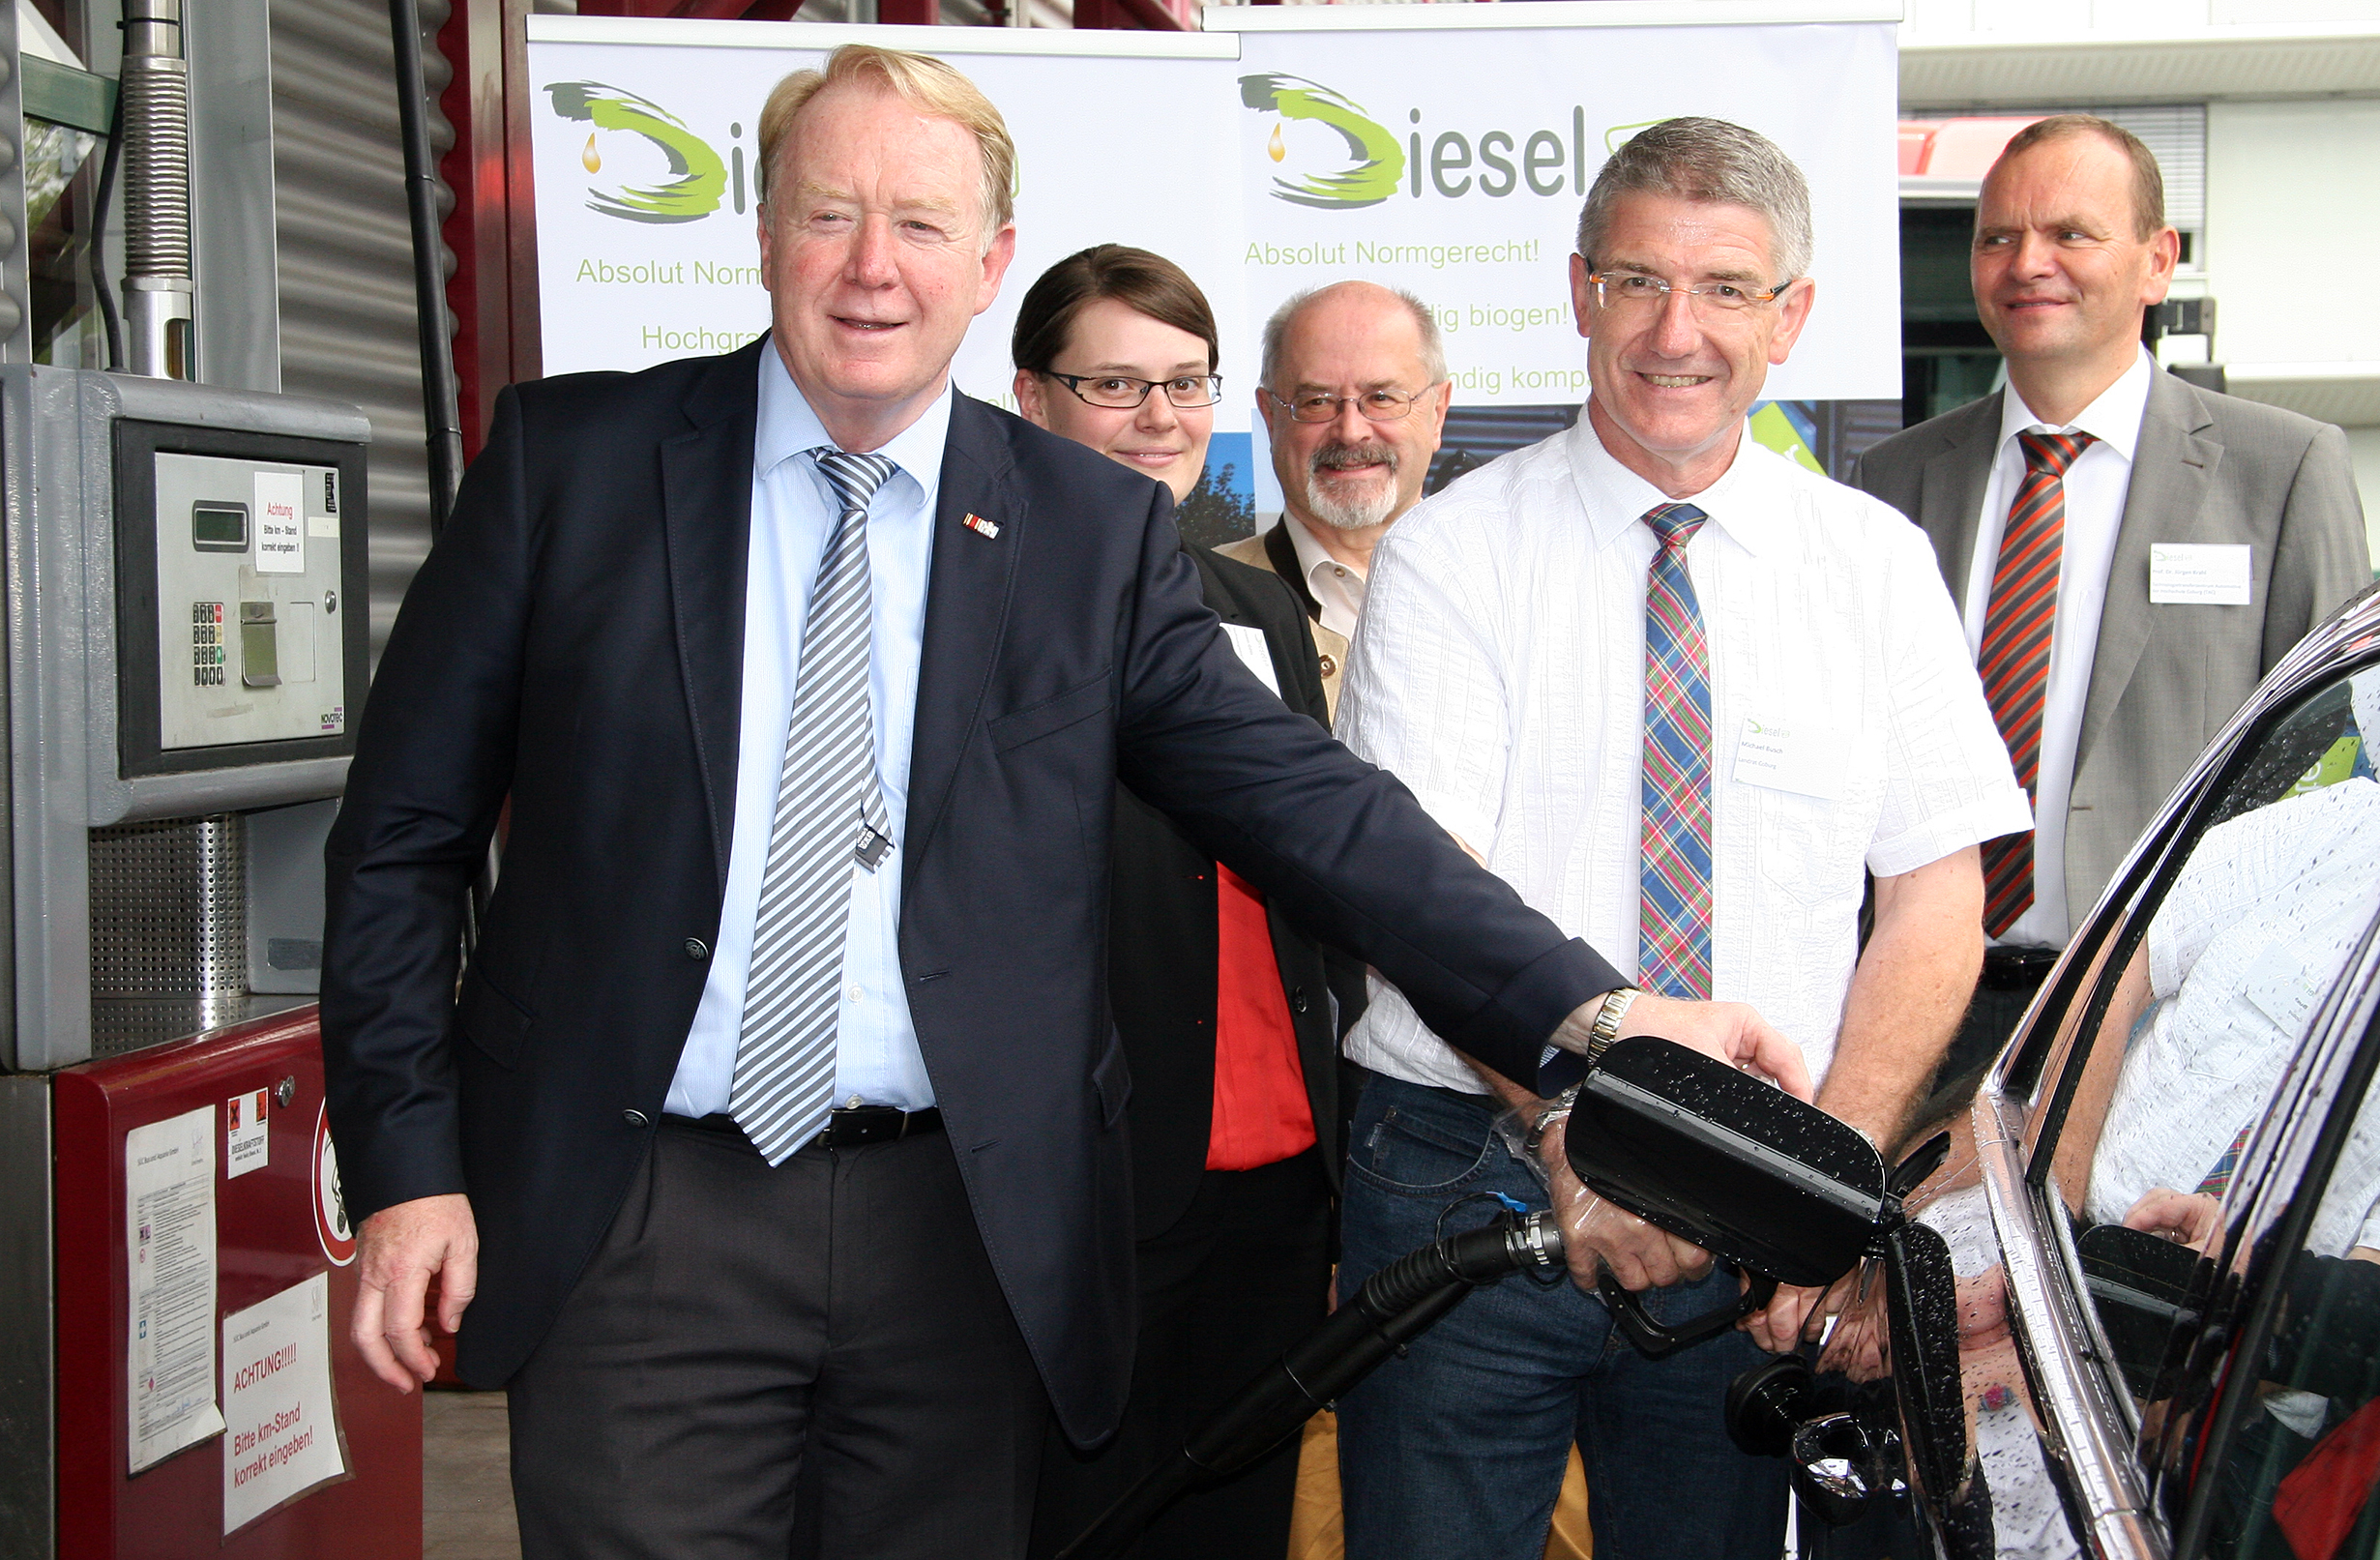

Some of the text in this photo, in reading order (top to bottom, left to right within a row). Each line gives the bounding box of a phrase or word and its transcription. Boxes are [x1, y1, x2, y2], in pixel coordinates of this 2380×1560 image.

[1238, 72, 1585, 210] Diesel
[1245, 239, 1541, 270] Absolut Normgerecht!
[576, 258, 685, 284] Absolut
[1470, 301, 1569, 332] biogen!
[1512, 366, 1592, 393] komp
[267, 502, 293, 520] Achtung
[263, 524, 274, 535] Bitte
[285, 526, 297, 535] Stand
[261, 542, 277, 552] korrekt
[277, 542, 296, 554] eingeben
[233, 1341, 297, 1394] ACHTUNG!!!!!
[234, 1401, 301, 1457] Bitte km-Stand
[234, 1425, 313, 1488] korrekt eingeben!
